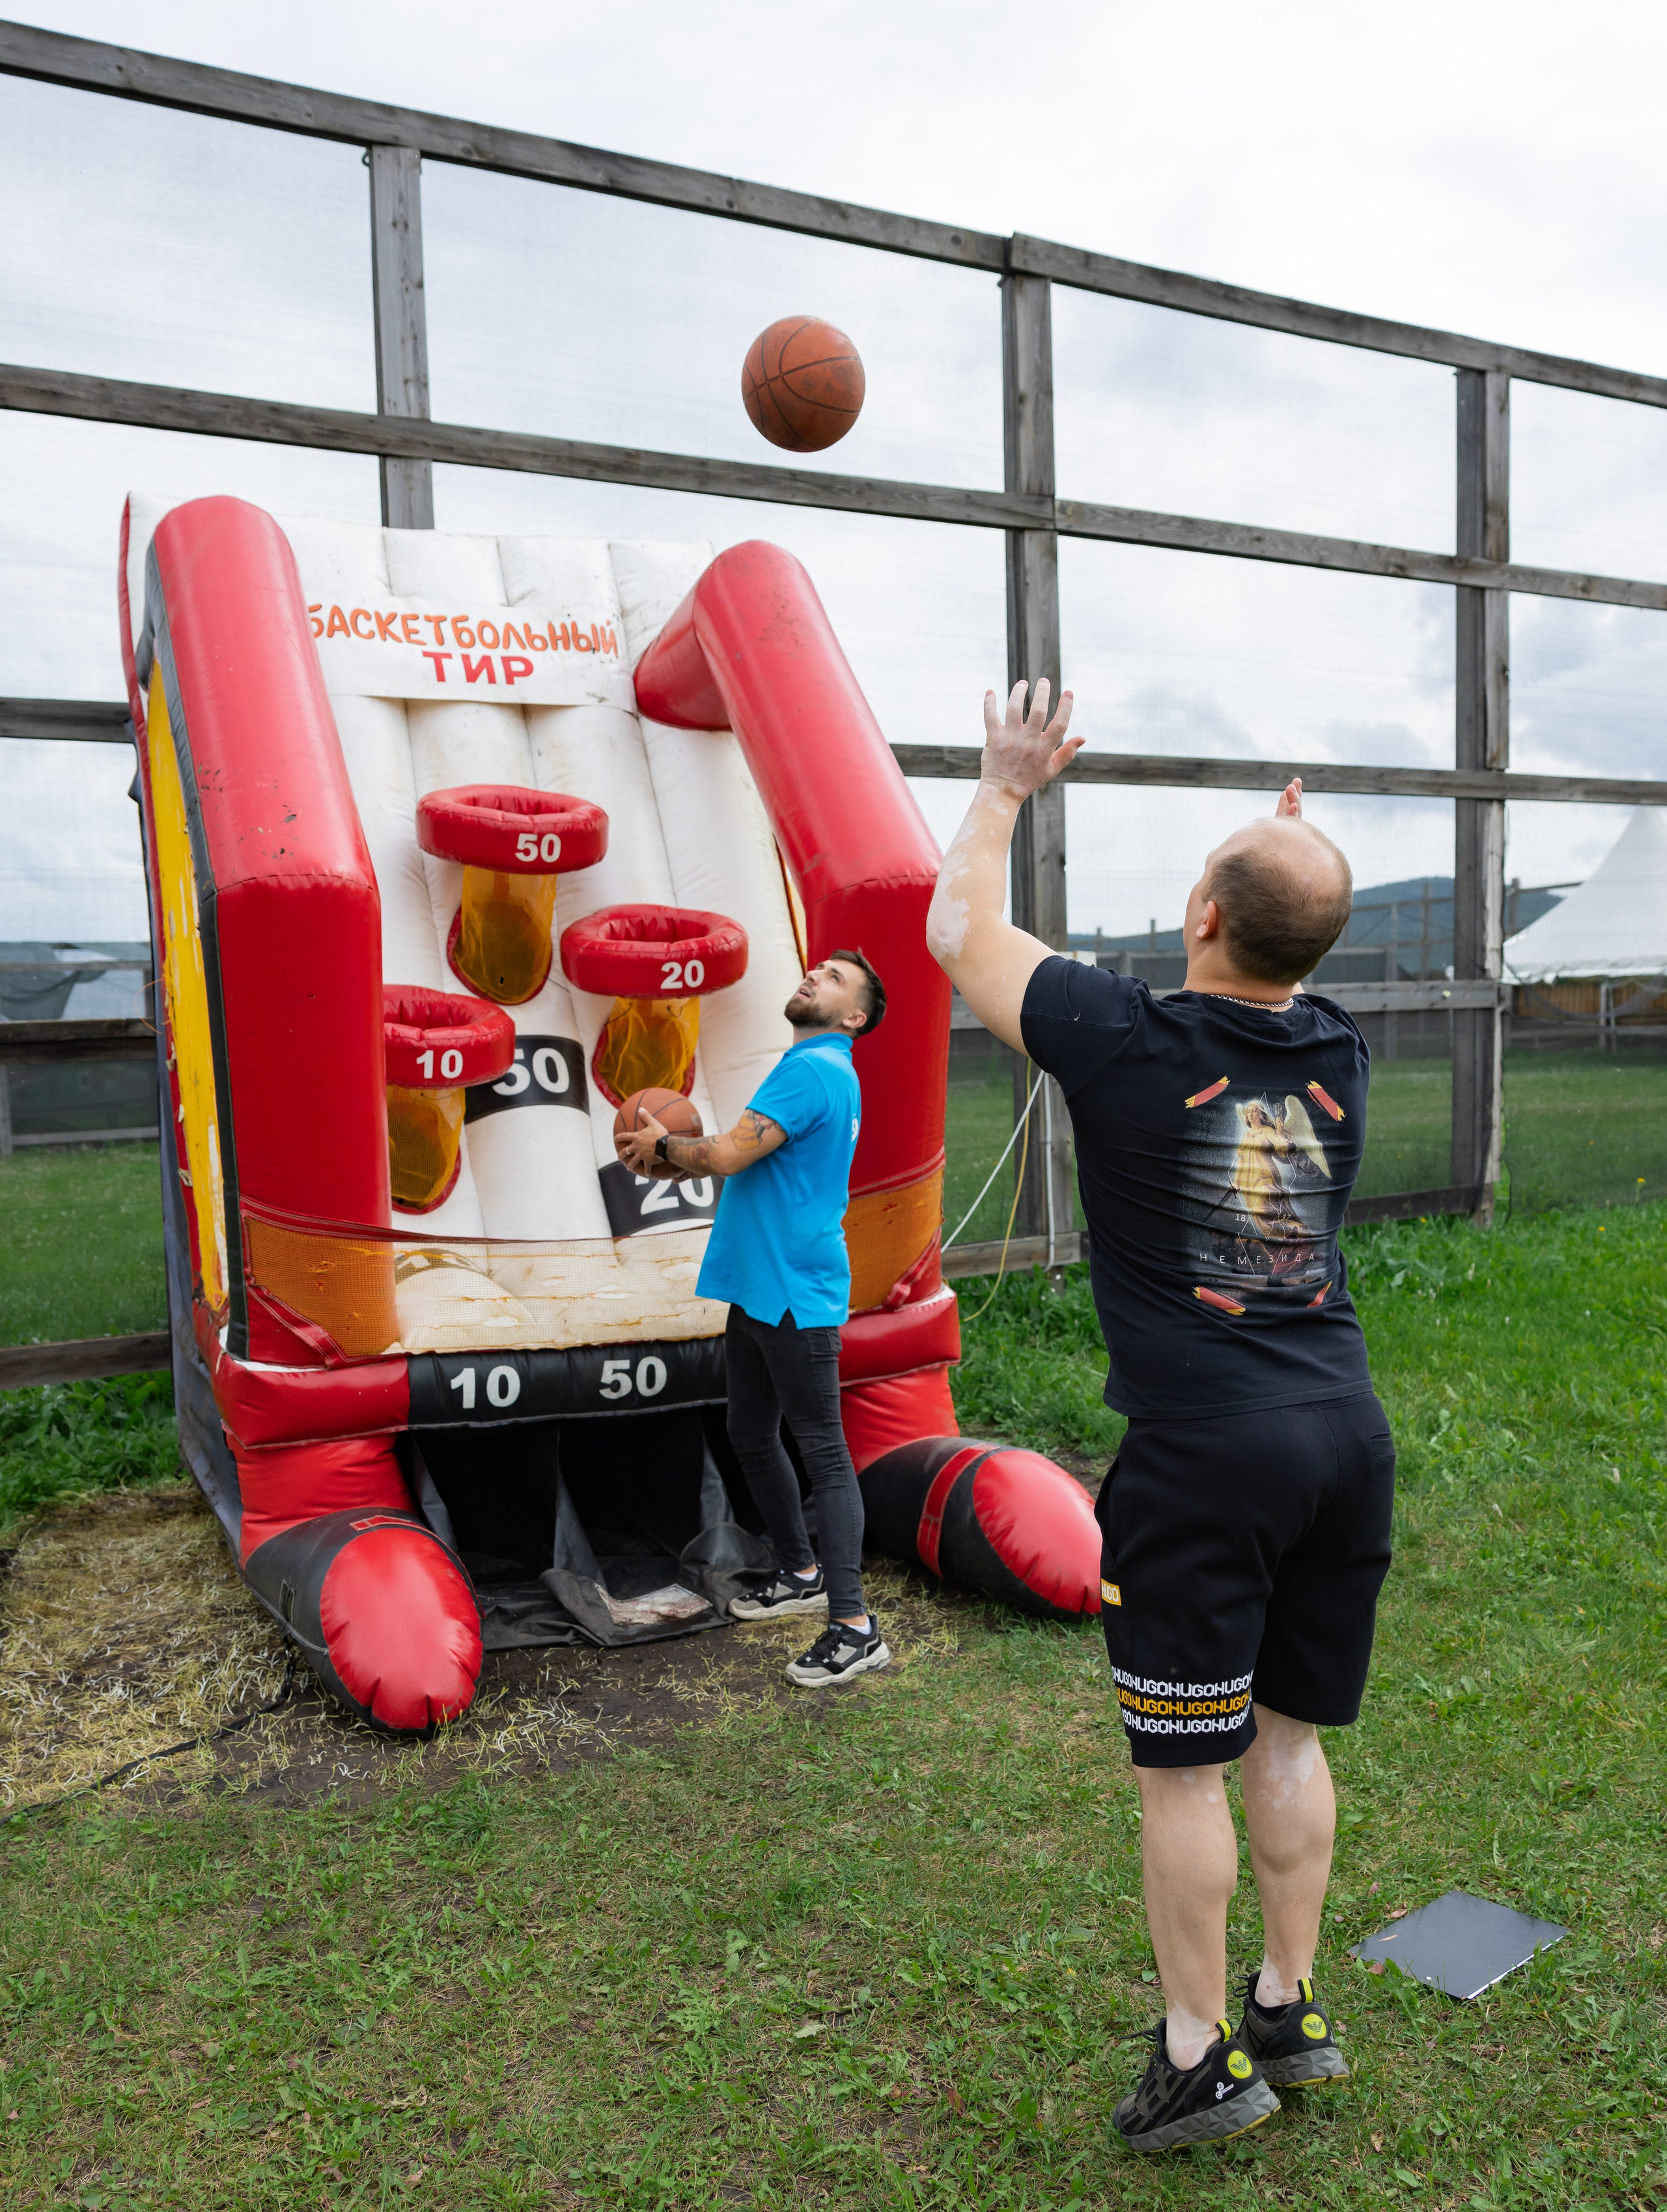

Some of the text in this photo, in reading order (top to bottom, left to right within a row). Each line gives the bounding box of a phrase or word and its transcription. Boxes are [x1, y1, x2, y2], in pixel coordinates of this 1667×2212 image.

[423, 651, 533, 684] ТИР
[515, 833, 561, 863] 50
[660, 960, 705, 989] 20
[416, 1049, 463, 1079] 10
[492, 1047, 570, 1096] 50
[635, 1175, 714, 1216] 20
[1199, 1253, 1314, 1265] НЕМЕЗИДА
[451, 1356, 667, 1408] 10 50
